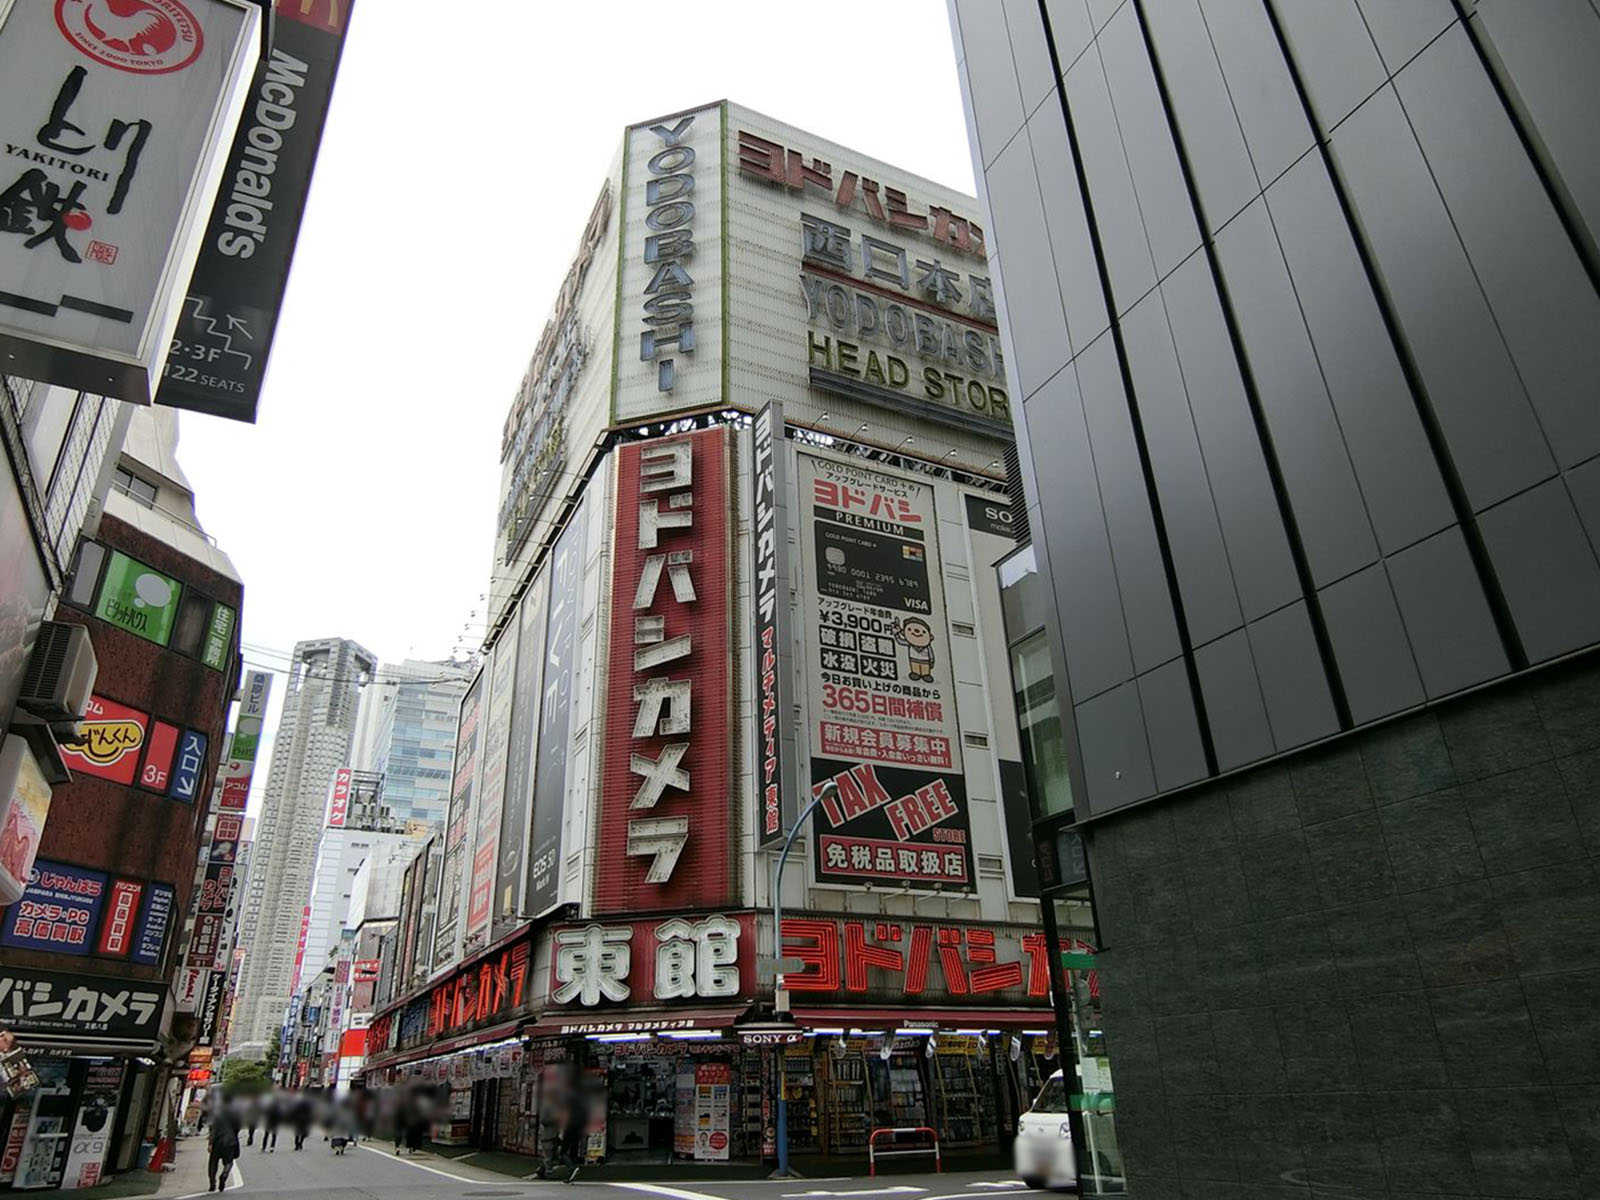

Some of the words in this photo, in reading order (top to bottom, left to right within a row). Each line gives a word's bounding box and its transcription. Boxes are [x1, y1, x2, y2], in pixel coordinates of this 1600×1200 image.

[6, 143, 109, 182] YAKITORI
[217, 48, 310, 260] McDonald's
[641, 115, 697, 393] YODOBASHI
[807, 331, 910, 389] HEAD
[199, 374, 246, 393] SEATS
[817, 459, 845, 476] GOLD
[845, 466, 873, 482] POINT
[874, 474, 899, 488] CARD
[826, 472, 909, 498] アップグレードサービス
[755, 408, 775, 624] ヨドバシカメラ
[814, 478, 922, 523] ヨドバシ
[836, 511, 905, 536] PREMIUM
[818, 597, 893, 619] アップグレード年会費
[903, 597, 929, 611] VISA
[627, 440, 698, 885] ヨドバシカメラ
[862, 658, 896, 678] 火災
[821, 671, 941, 700] 今日お買い上げの商品から
[762, 625, 777, 784] マルチメディア
[822, 684, 944, 723] 365日間補償
[181, 736, 202, 773] 入口
[824, 723, 946, 755] 新規会員募集中
[143, 764, 167, 784] 3F
[331, 773, 351, 821] カラオケ
[812, 762, 892, 829] TAX
[884, 778, 960, 842] FREE
[932, 828, 967, 844] STORE
[825, 843, 964, 877] 免税品取扱店
[40, 872, 102, 896] じゃんぱら
[551, 913, 742, 1007] 東館
[561, 1022, 624, 1034] ヨドバシカメラ
[743, 1034, 781, 1044] SONY
[903, 1019, 939, 1029] Panasonic
